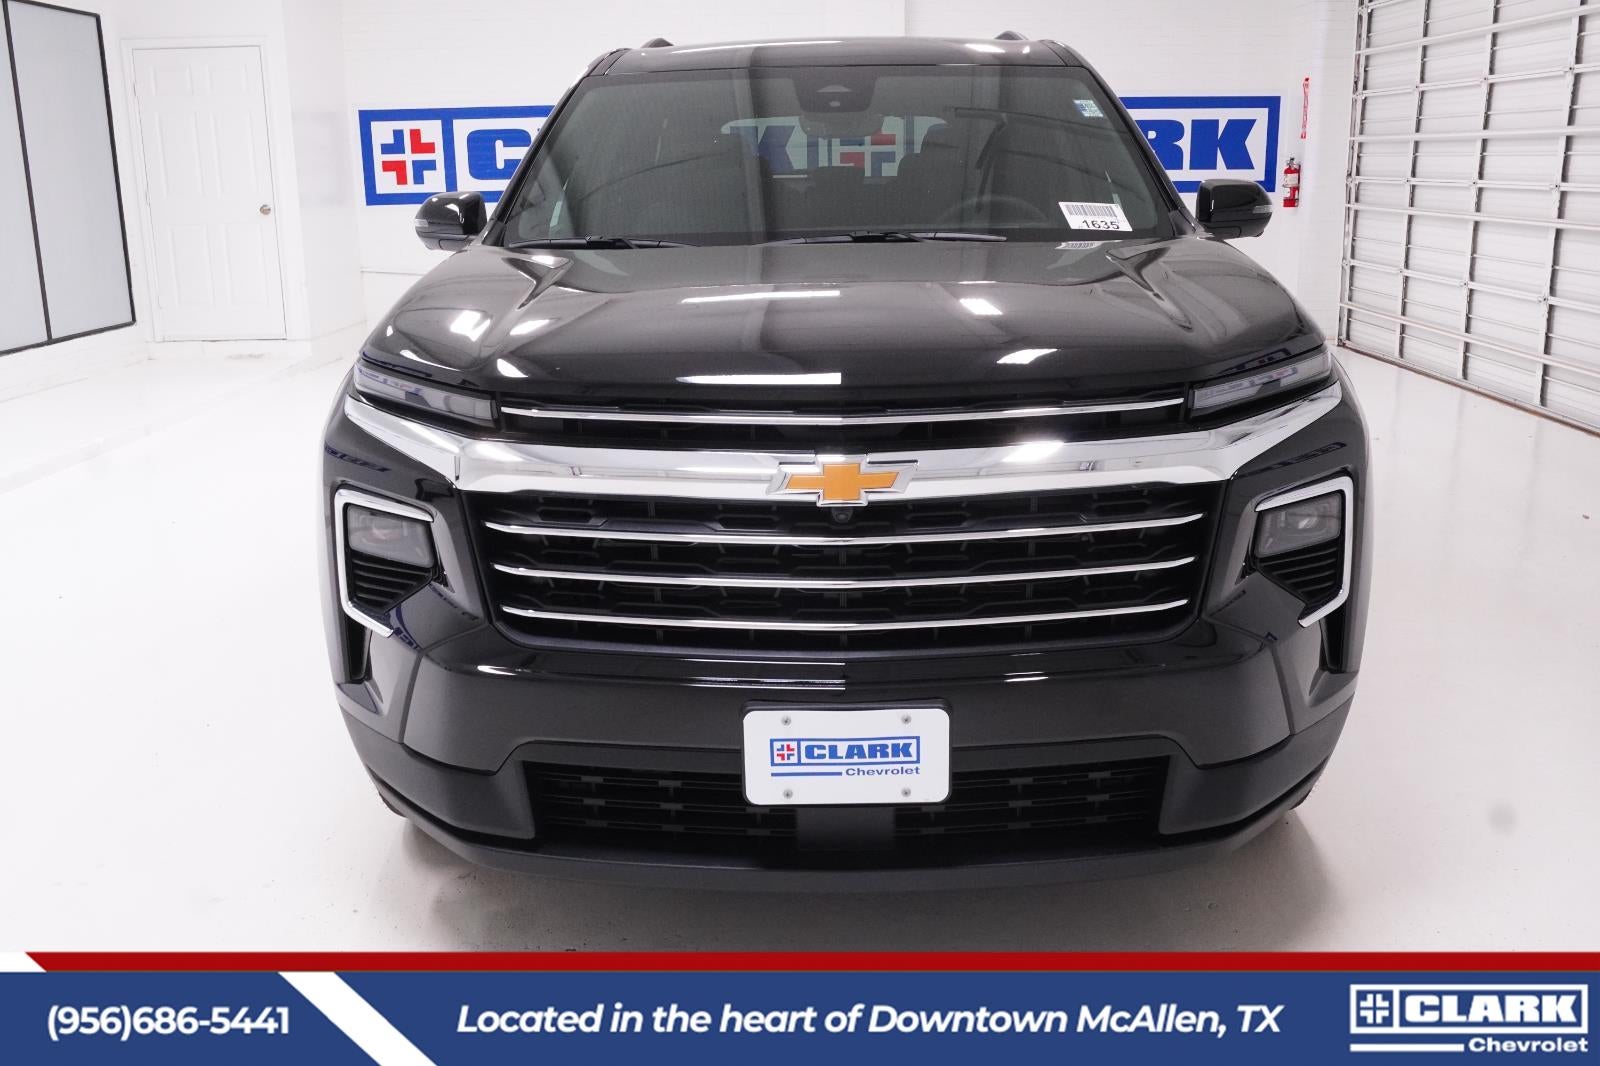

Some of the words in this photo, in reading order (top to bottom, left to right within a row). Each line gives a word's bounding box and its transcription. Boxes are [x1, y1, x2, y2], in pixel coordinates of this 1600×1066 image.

[1082, 219, 1121, 230] 1635
[804, 742, 913, 760] CLARK
[845, 766, 921, 777] Chevrolet
